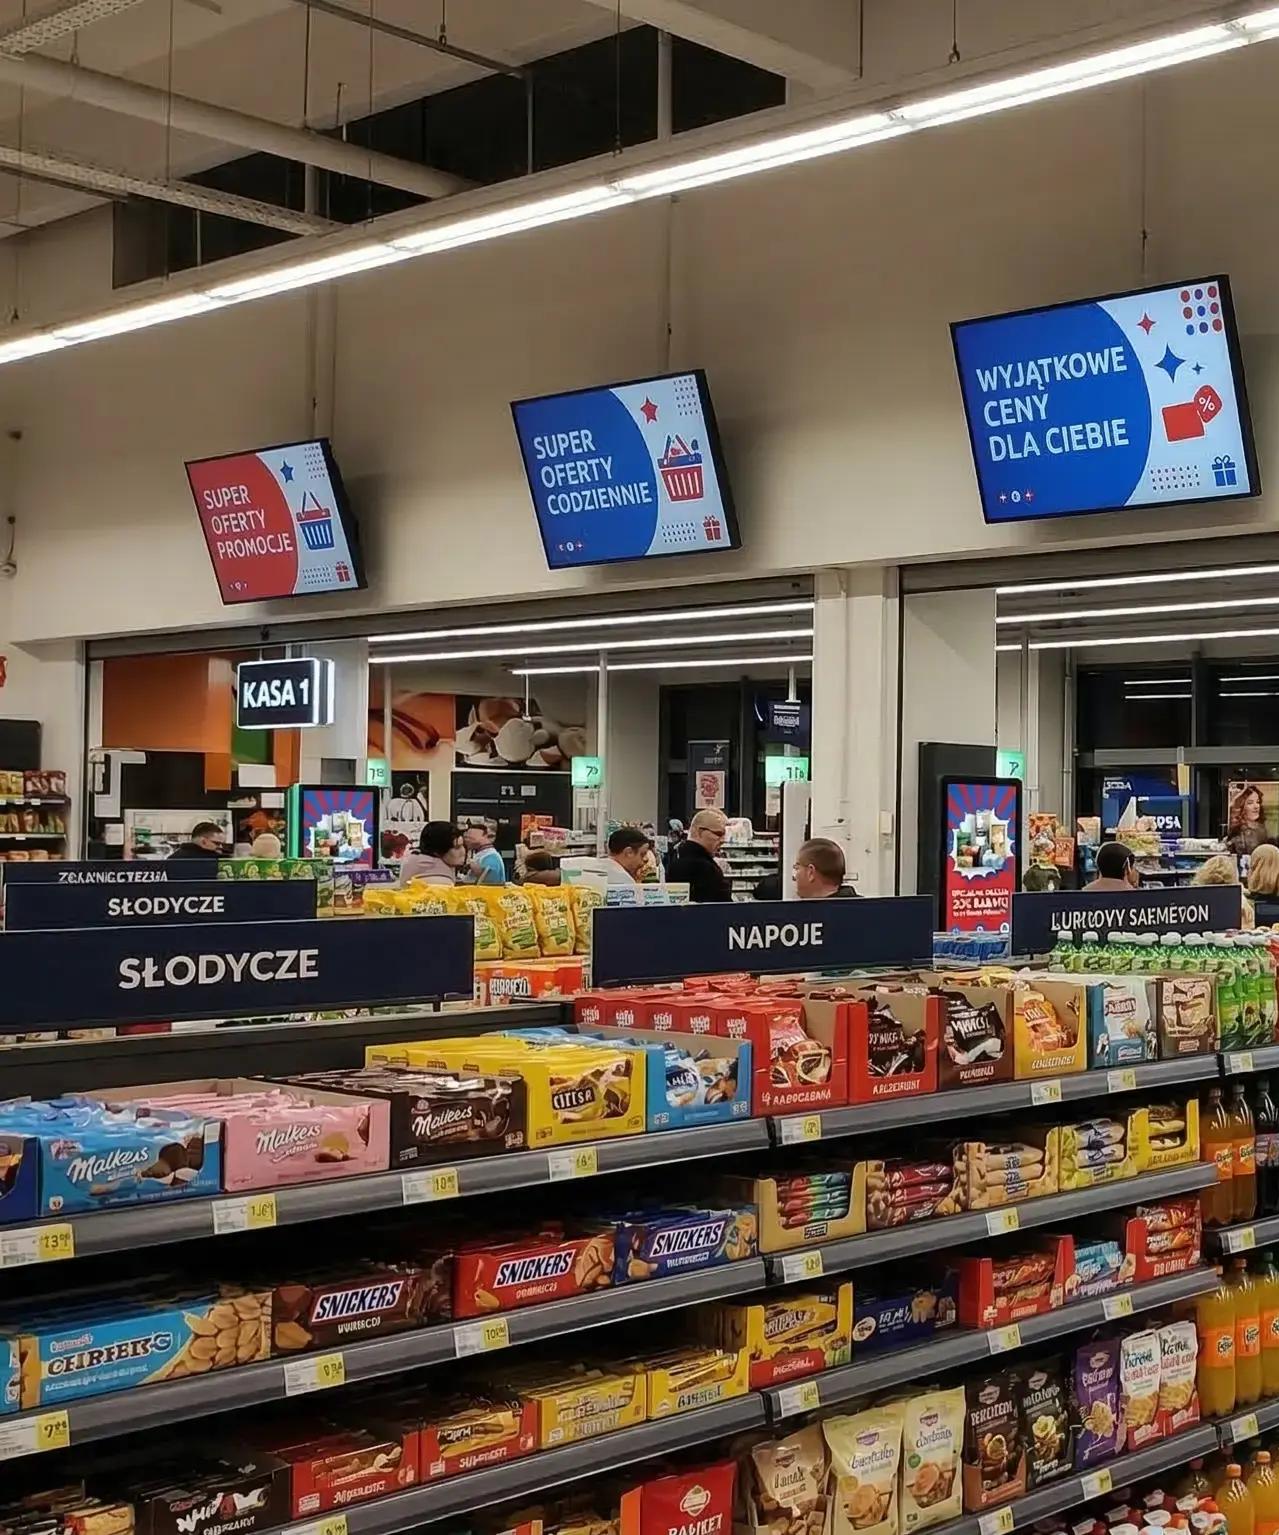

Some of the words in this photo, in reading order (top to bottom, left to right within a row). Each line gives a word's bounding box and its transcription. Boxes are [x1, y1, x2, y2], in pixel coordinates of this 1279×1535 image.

[975, 345, 1128, 393] WYJĄTKOWE
[983, 393, 1049, 428] CENY
[533, 429, 596, 460] SUPER
[988, 431, 1041, 462] DLA
[1045, 418, 1130, 455] CIEBIE
[541, 456, 613, 488] OFERTY
[203, 484, 252, 510] SUPER
[547, 481, 653, 516] CODZIENNIE
[211, 508, 266, 535] OFERTY
[217, 532, 294, 560] PROMOCJE
[242, 679, 296, 709] KASA
[299, 678, 310, 705] 1
[106, 896, 226, 916] SŁODYCZE
[727, 922, 824, 951] NAPOJE
[117, 948, 321, 990] SŁODYCZE
[654, 1222, 724, 1257] SNICKERS
[496, 1251, 574, 1286] SNICKERS
[314, 1282, 402, 1320] SNICKERS
